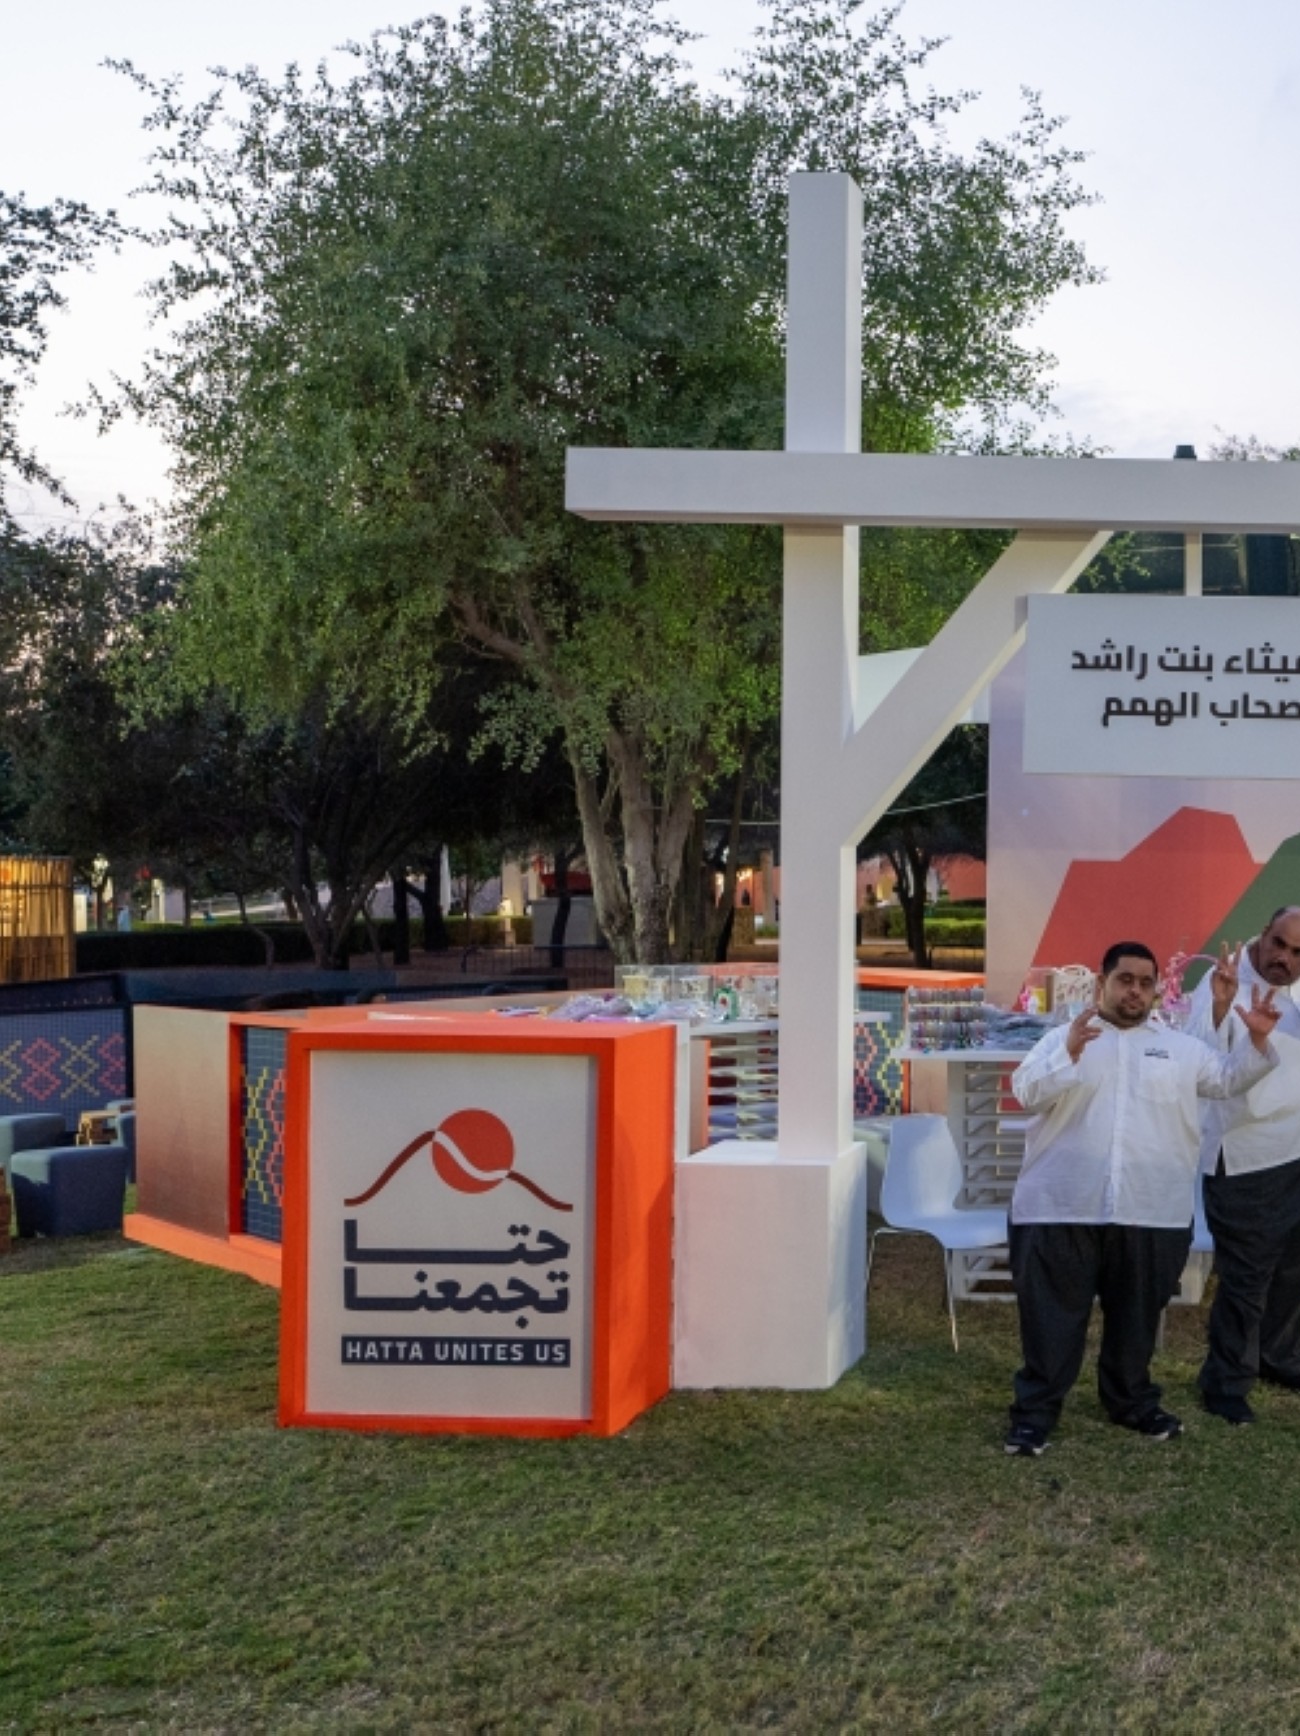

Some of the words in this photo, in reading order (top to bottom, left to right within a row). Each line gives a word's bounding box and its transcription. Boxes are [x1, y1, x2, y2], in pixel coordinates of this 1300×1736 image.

[1071, 638, 1148, 681] راشد
[1157, 646, 1214, 682] بنت
[1101, 691, 1199, 728] الهمم
[346, 1341, 424, 1362] HATTA
[434, 1342, 524, 1363] UNITES
[534, 1343, 568, 1364] US
